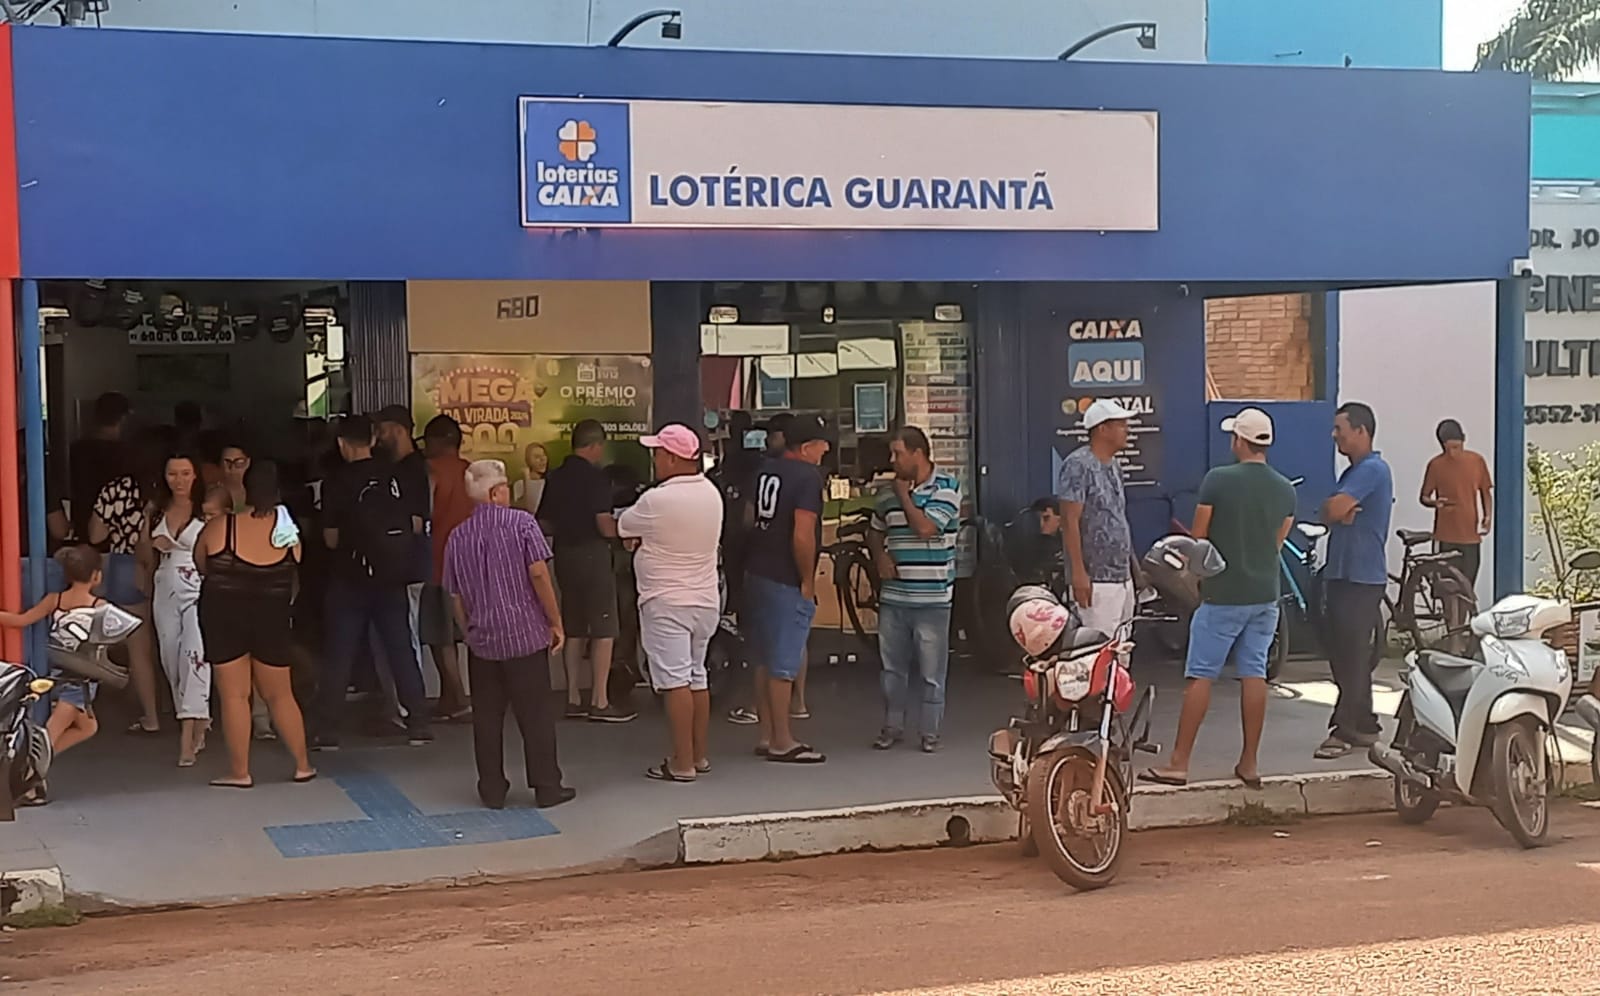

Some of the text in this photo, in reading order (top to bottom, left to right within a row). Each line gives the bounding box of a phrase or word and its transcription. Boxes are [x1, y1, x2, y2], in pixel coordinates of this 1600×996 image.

[536, 161, 619, 183] loterias
[537, 184, 620, 207] CAIXA
[649, 165, 1055, 211] LOTÉRICA GUARANTÃ
[1068, 319, 1142, 340] CAIXA
[1072, 359, 1142, 383] AQUI
[440, 377, 532, 404] MEGA
[560, 382, 637, 400] O PRÊMIO
[463, 407, 510, 424] VIRADA
